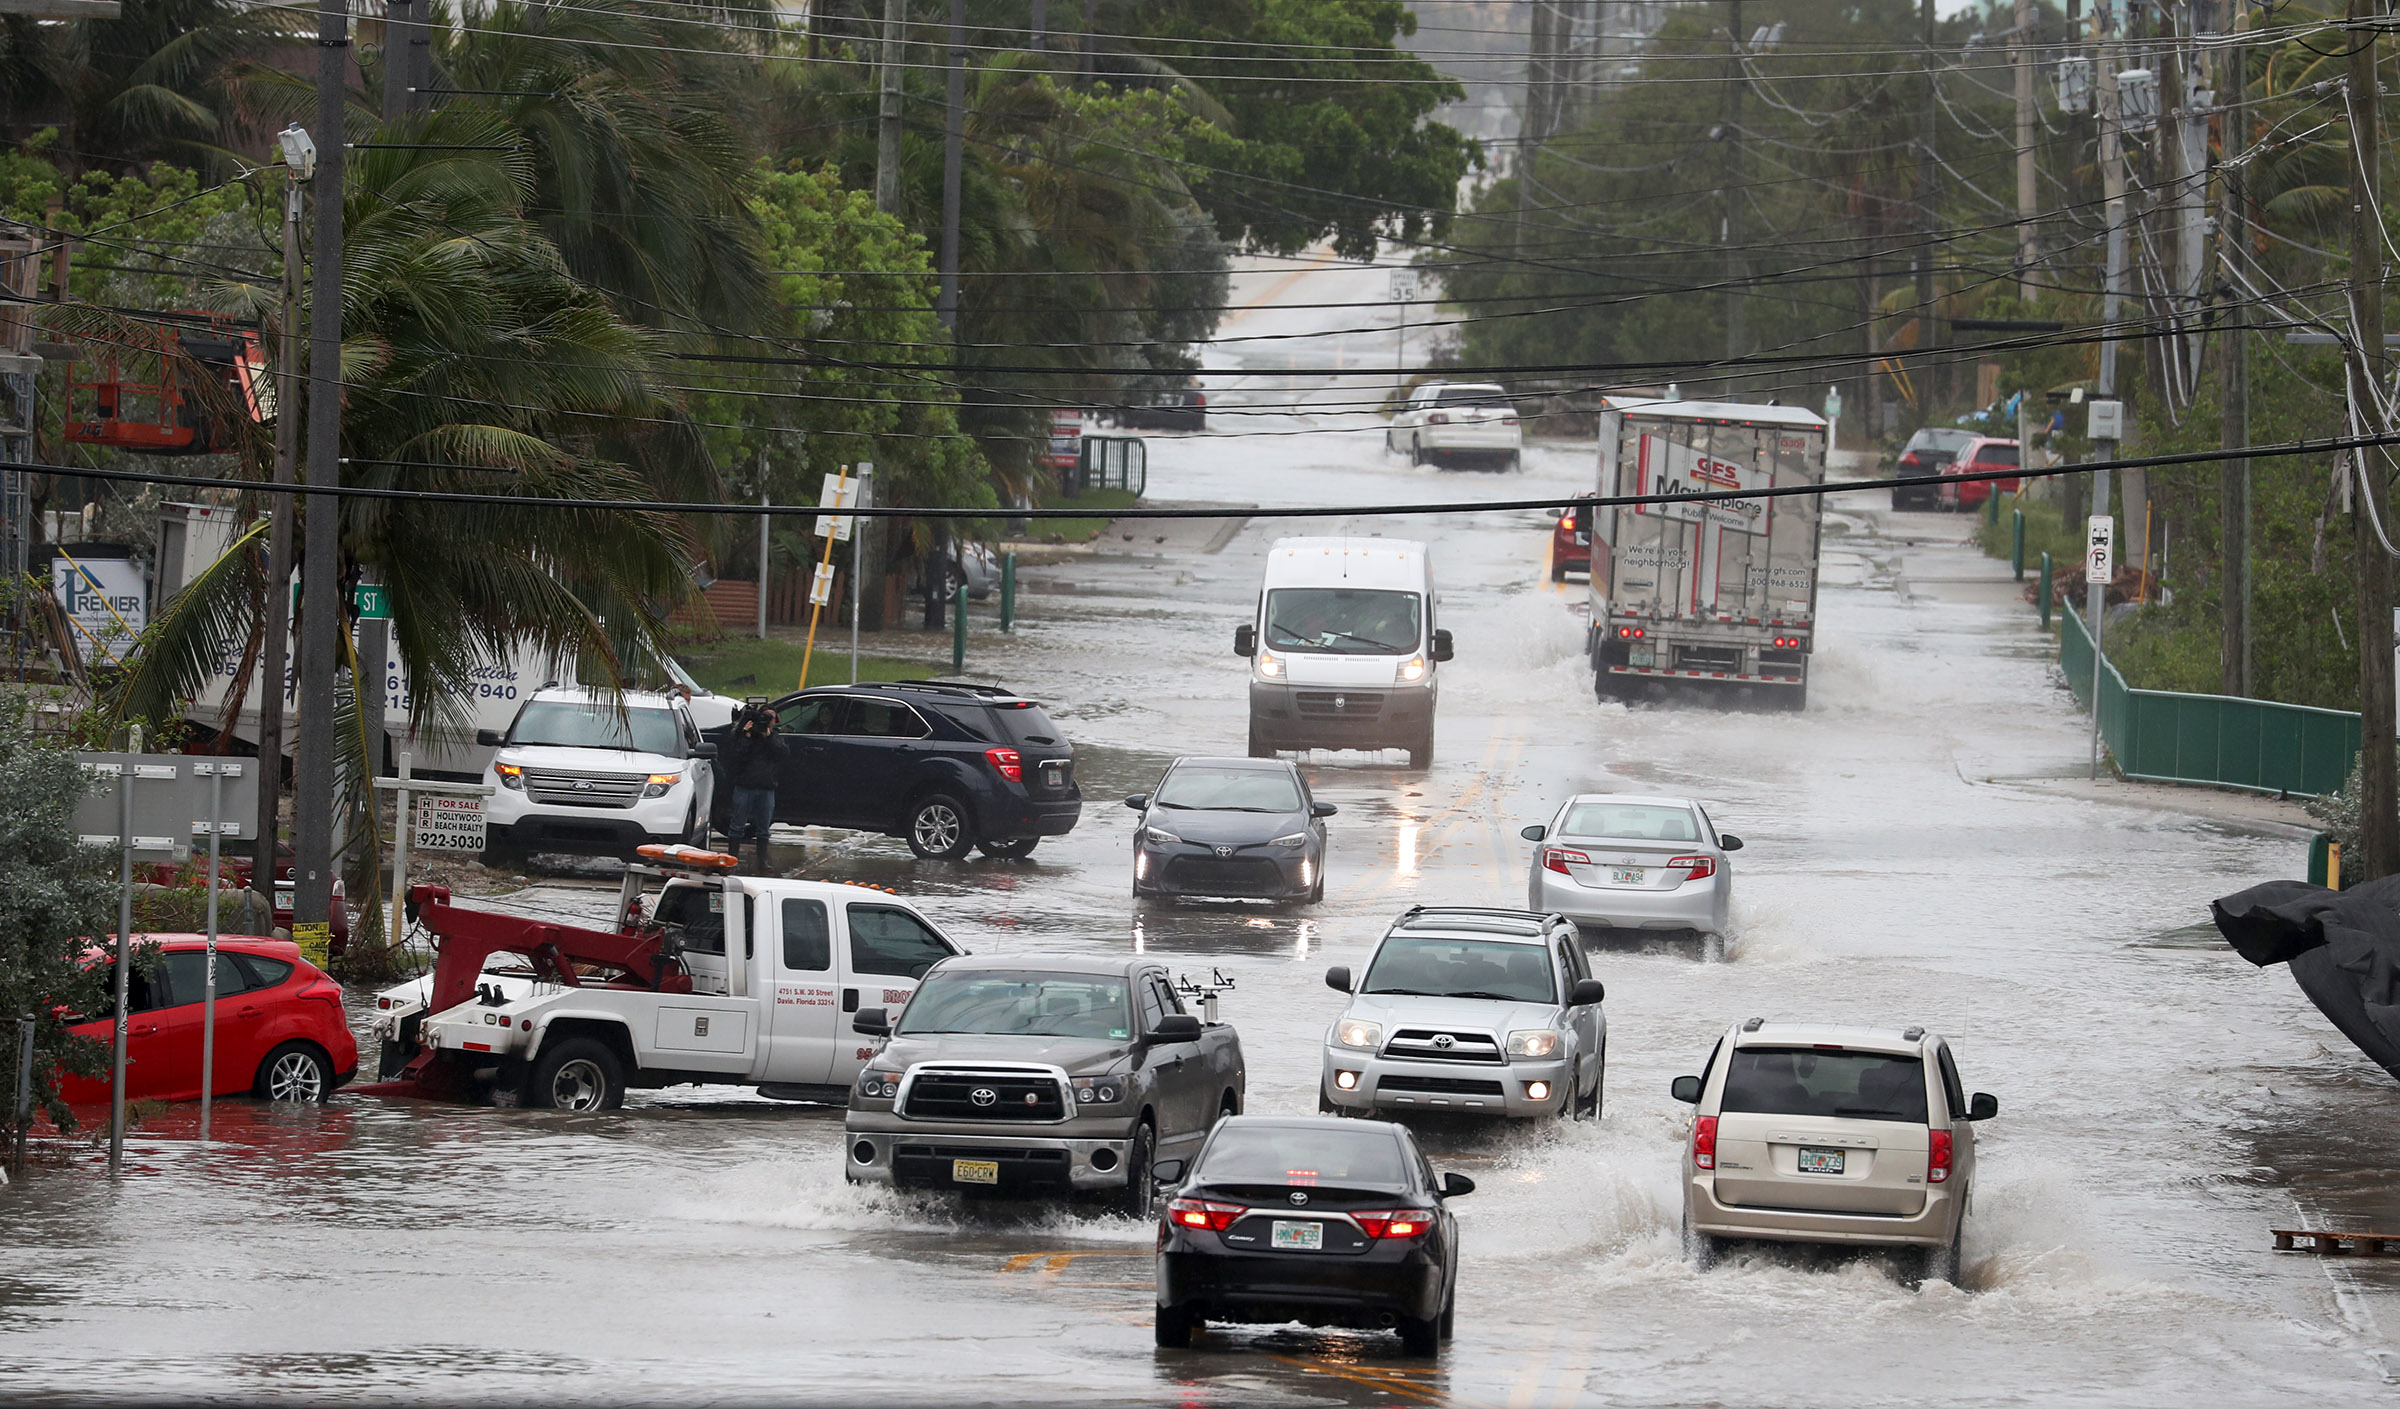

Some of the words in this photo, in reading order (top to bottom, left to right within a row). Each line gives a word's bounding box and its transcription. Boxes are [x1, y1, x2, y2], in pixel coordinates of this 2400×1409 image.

[1393, 288, 1415, 301] 35
[1697, 457, 1736, 479] GFS
[1709, 512, 1744, 527] Welcome
[1628, 545, 1655, 555] We're
[61, 568, 140, 615] PREMIER
[363, 592, 377, 611] ST
[438, 800, 456, 808] FOR
[459, 801, 480, 810] SALE
[437, 812, 483, 822] HOLLYWOOD
[435, 821, 458, 831] BEACH
[459, 822, 484, 833] REALTY
[420, 832, 484, 850] 922-5030
